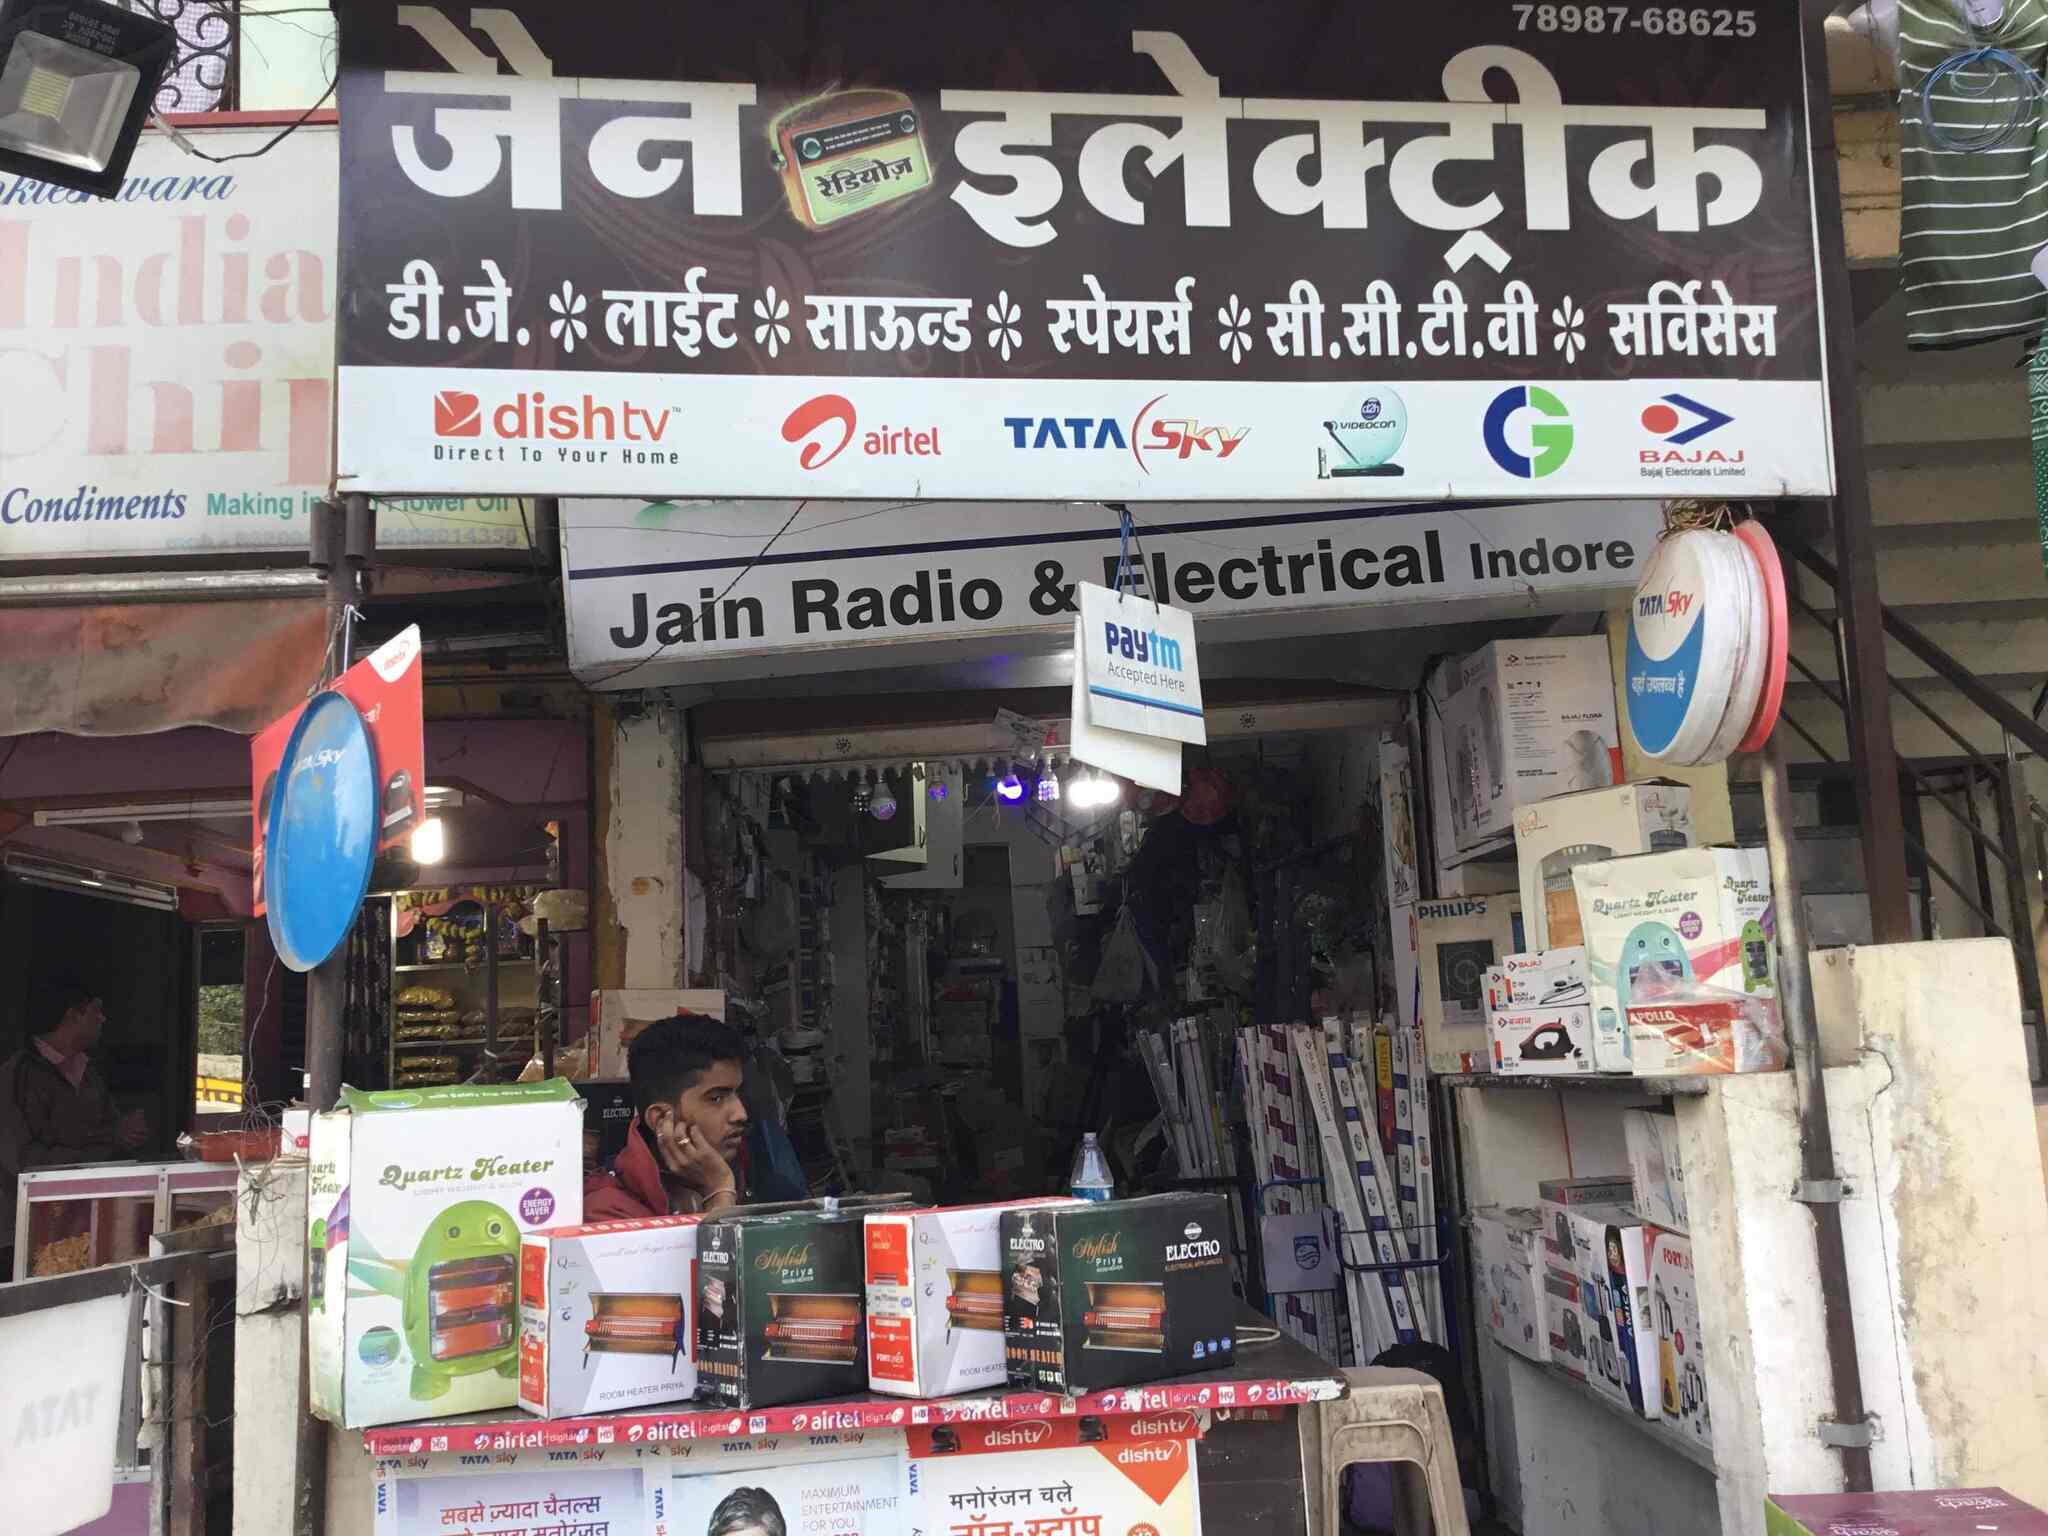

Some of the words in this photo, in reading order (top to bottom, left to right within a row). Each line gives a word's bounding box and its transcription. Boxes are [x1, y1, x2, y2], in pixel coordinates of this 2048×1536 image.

[1512, 4, 1757, 38] 78987-68625
[384, 5, 757, 217] जैन
[385, 258, 530, 344] डी.जे.
[602, 266, 739, 358] लाईट
[863, 424, 942, 456] airtel
[1003, 417, 1129, 449] TATA
[433, 444, 505, 462] Direct
[520, 446, 544, 463] To
[557, 447, 608, 465] Your
[623, 449, 679, 465] Home
[1639, 450, 1745, 464] BAJAJ
[1665, 467, 1712, 477] Electricals
[1713, 467, 1746, 477] Limited
[1, 484, 187, 525] Condiments
[206, 493, 294, 520] Making
[608, 586, 765, 651] Jain
[791, 567, 1004, 635] Radio
[1028, 559, 1081, 617] &
[1470, 533, 1636, 582] Indore
[1639, 594, 1663, 617] TATA
[1108, 661, 1158, 687] Accepted
[1159, 673, 1185, 693] Here
[1417, 900, 1487, 920] PHILIPS
[1629, 1010, 1677, 1024] APOLLO
[602, 1106, 632, 1119] ELECTRO
[378, 1164, 464, 1191] Quartz
[469, 1155, 555, 1182] Heater
[522, 1198, 553, 1209] ENERGY
[524, 1206, 551, 1217] SAVER
[1009, 1237, 1045, 1252] ELECTRO
[1164, 1239, 1220, 1262] ELECTRO
[702, 1250, 729, 1265] ELECTRO
[599, 1390, 626, 1401] ROOM
[626, 1385, 660, 1399] HEATER
[660, 1381, 685, 1393] PRIYA
[494, 1431, 543, 1450] airtel
[646, 1420, 696, 1441] airtel
[811, 1410, 861, 1431] airtel
[459, 1454, 490, 1465] TATA
[548, 1451, 578, 1461] TATA
[722, 1441, 752, 1452] TATA
[808, 1436, 838, 1446] TATA
[1117, 1446, 1172, 1464] dishtv
[909, 1463, 918, 1496] TATA
[377, 1483, 387, 1514] TATA
[654, 1488, 664, 1520] TATA
[800, 1484, 861, 1500] MAXIMUM
[949, 1484, 1032, 1511] मनोरंजन
[1039, 1479, 1074, 1504] चले
[440, 1501, 485, 1526] सबसे
[801, 1496, 899, 1517] ENTERTAINMENT
[802, 1520, 828, 1532] FOR
